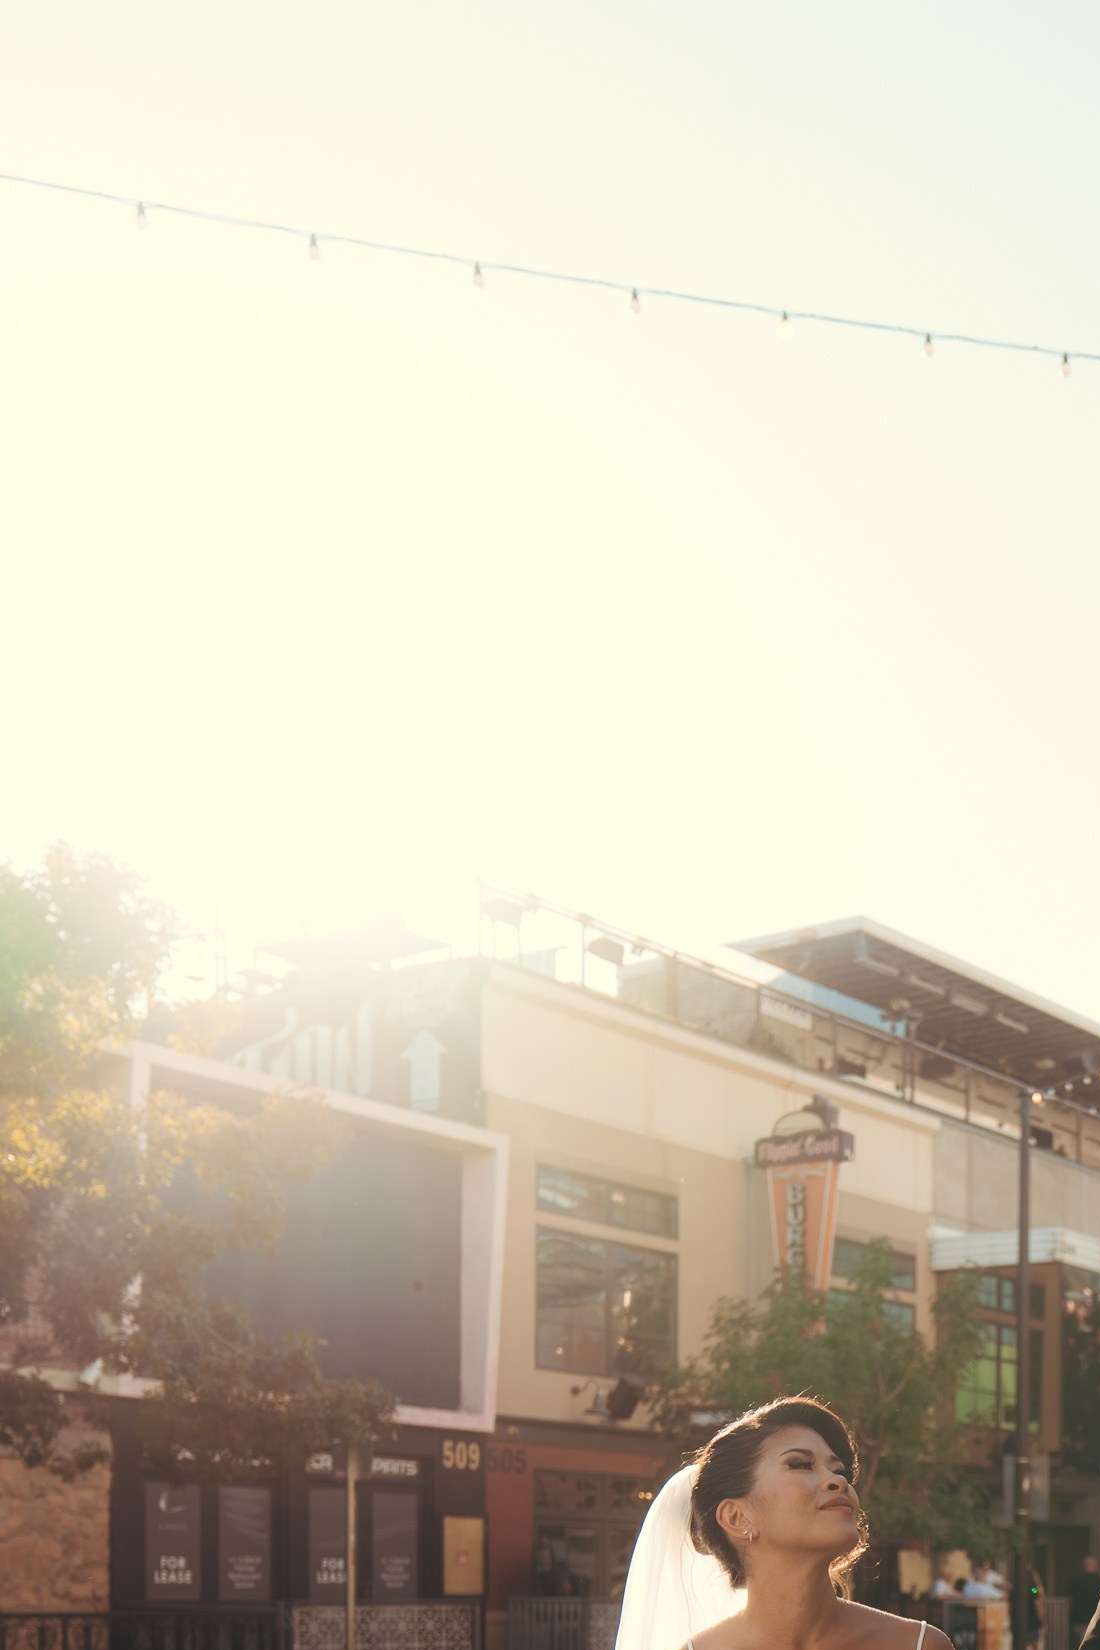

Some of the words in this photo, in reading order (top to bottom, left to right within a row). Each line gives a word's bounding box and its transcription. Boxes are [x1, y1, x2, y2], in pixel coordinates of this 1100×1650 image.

[443, 1440, 480, 1471] 509
[160, 1555, 186, 1569] FOR
[321, 1557, 345, 1571] FOR
[154, 1569, 192, 1584] LEASE
[316, 1571, 347, 1584] LEAS
